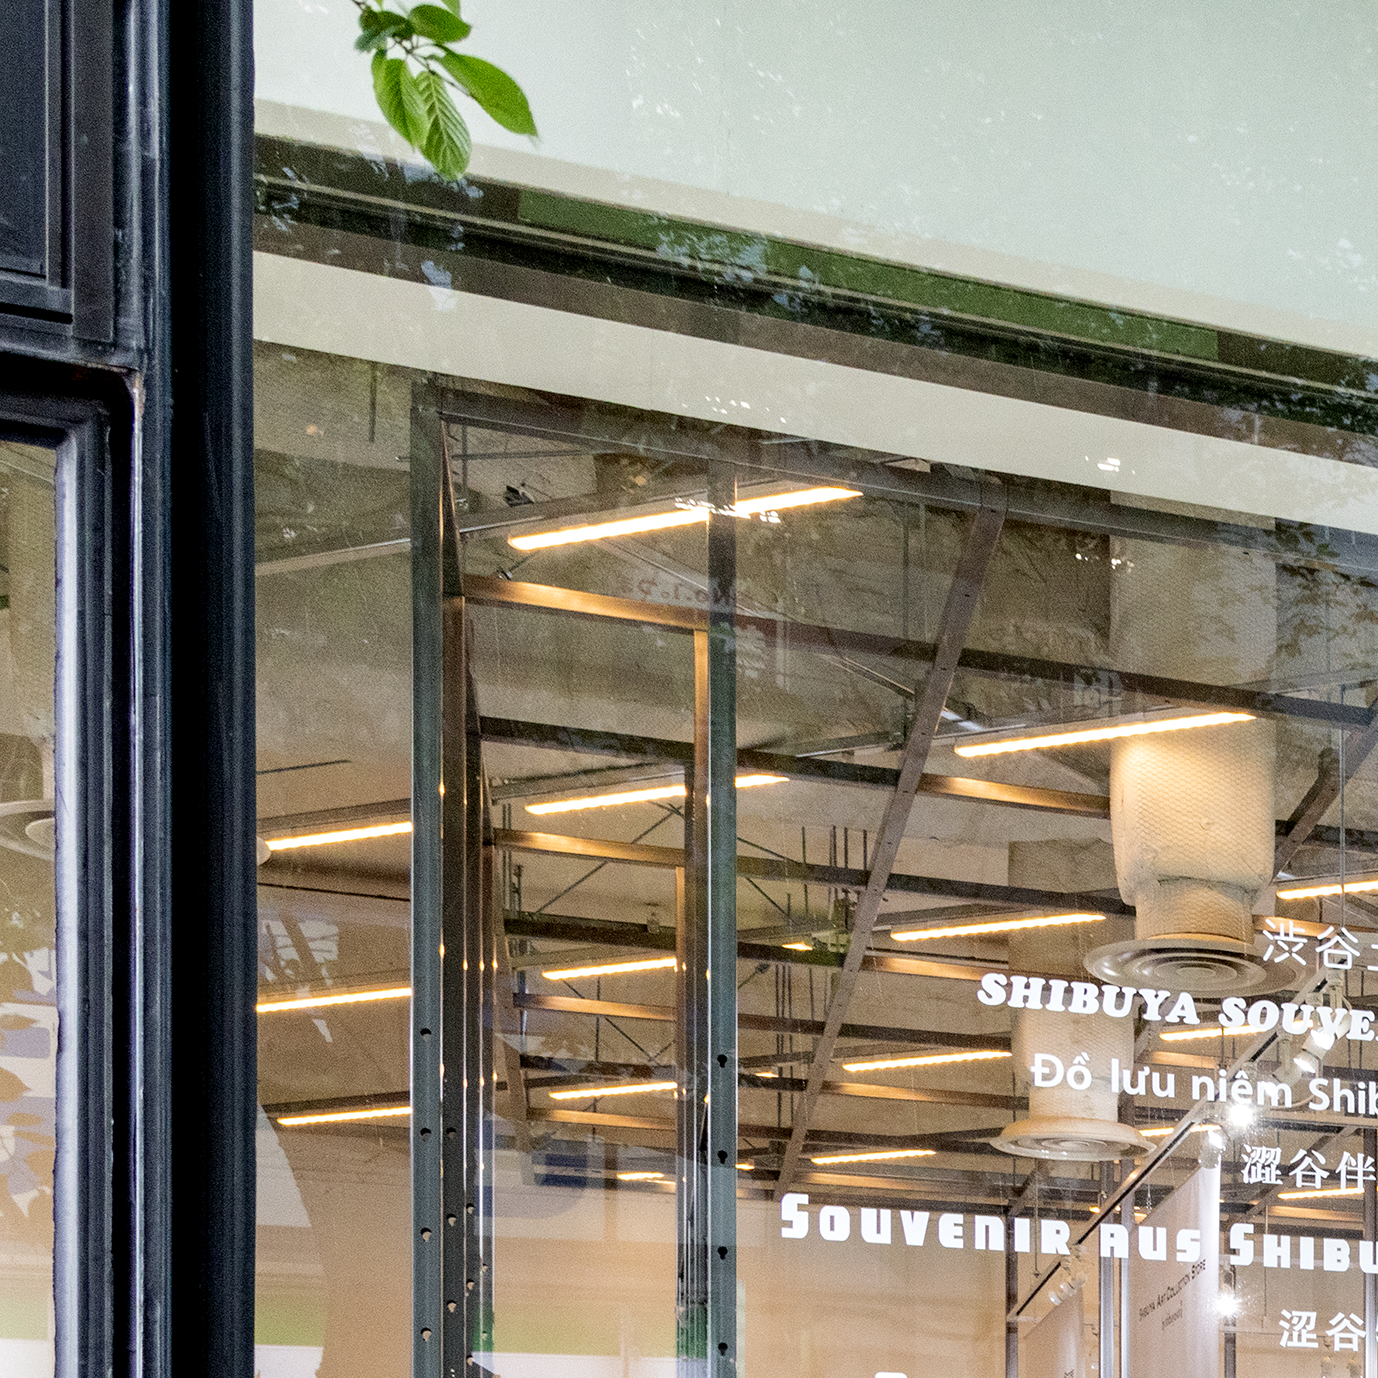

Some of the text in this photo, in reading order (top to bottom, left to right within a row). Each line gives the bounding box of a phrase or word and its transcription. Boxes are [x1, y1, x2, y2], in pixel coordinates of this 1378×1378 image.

[976, 972, 1201, 1025] SHIBUYA
[1030, 1051, 1093, 1091] Đồ
[1110, 1058, 1176, 1100] lưu
